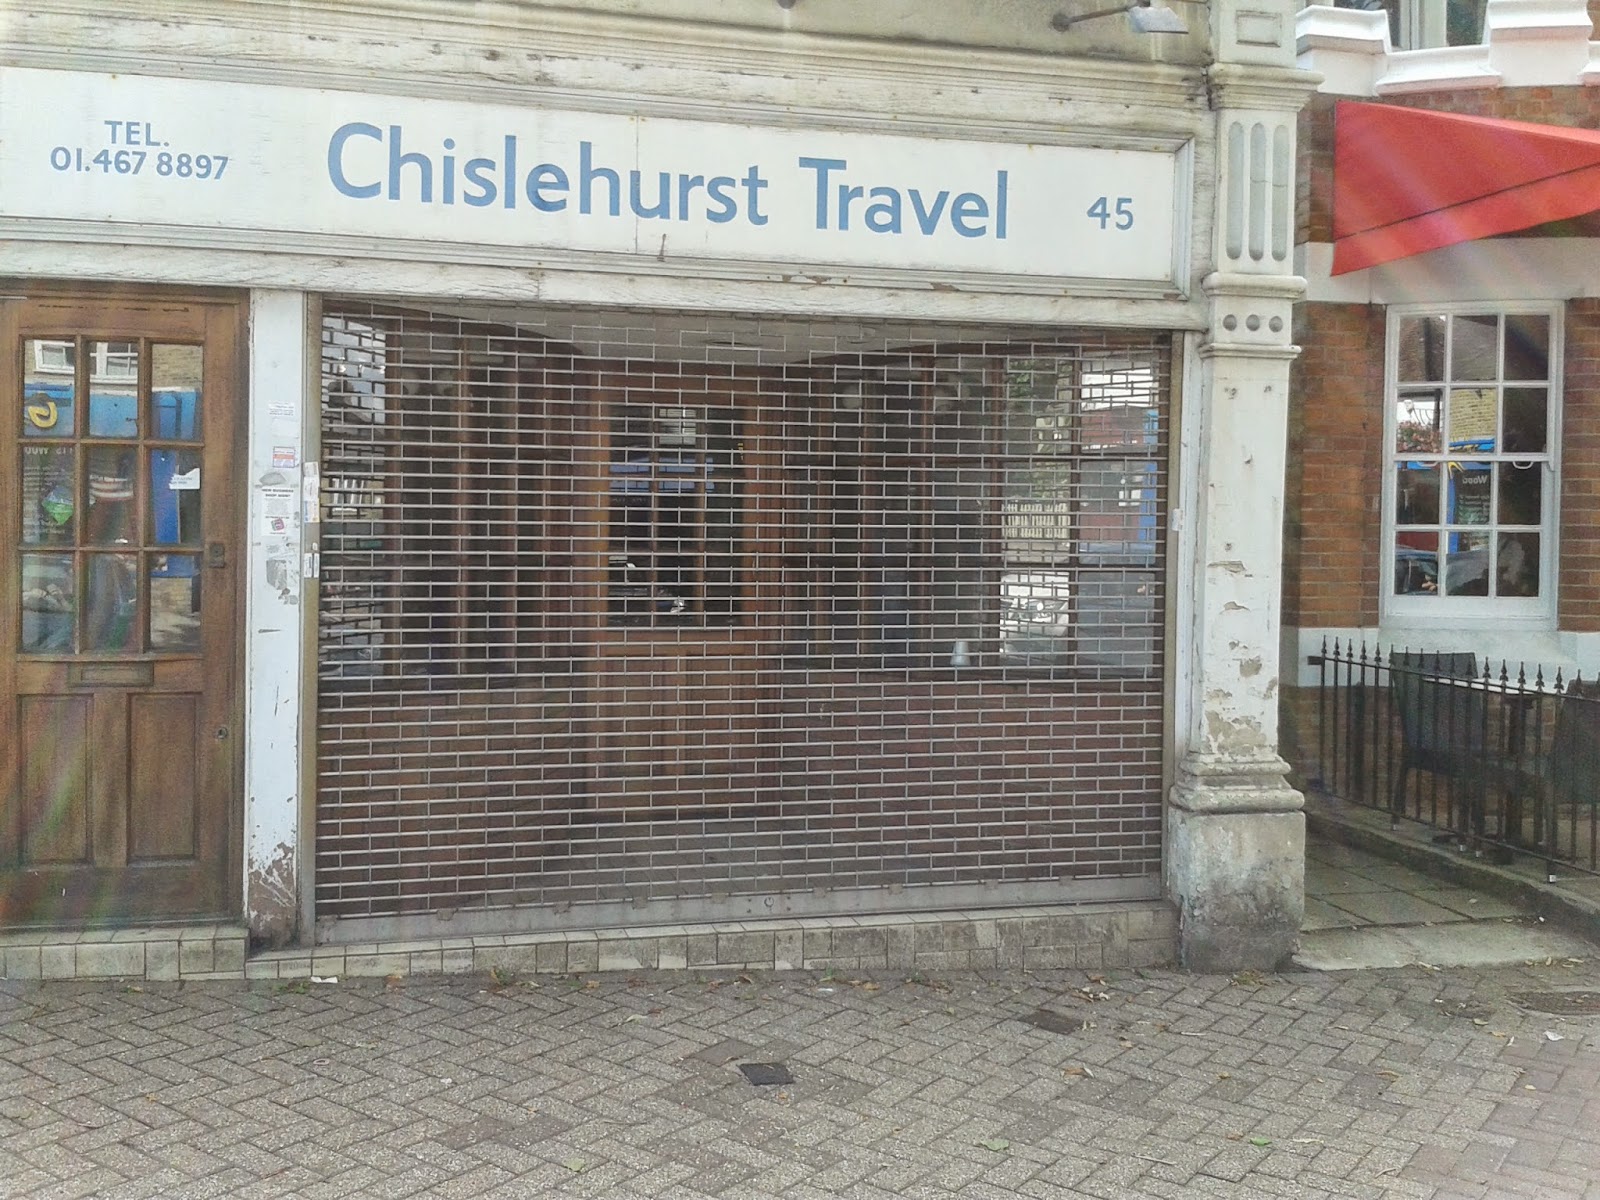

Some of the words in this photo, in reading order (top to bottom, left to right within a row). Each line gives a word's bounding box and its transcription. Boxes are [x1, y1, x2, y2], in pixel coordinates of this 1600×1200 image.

[104, 120, 170, 147] TEL.
[50, 146, 147, 175] 01.467
[156, 152, 229, 180] 8897
[328, 122, 769, 225] Chislehurst
[799, 156, 1008, 239] Travel
[1086, 197, 1134, 231] 45
